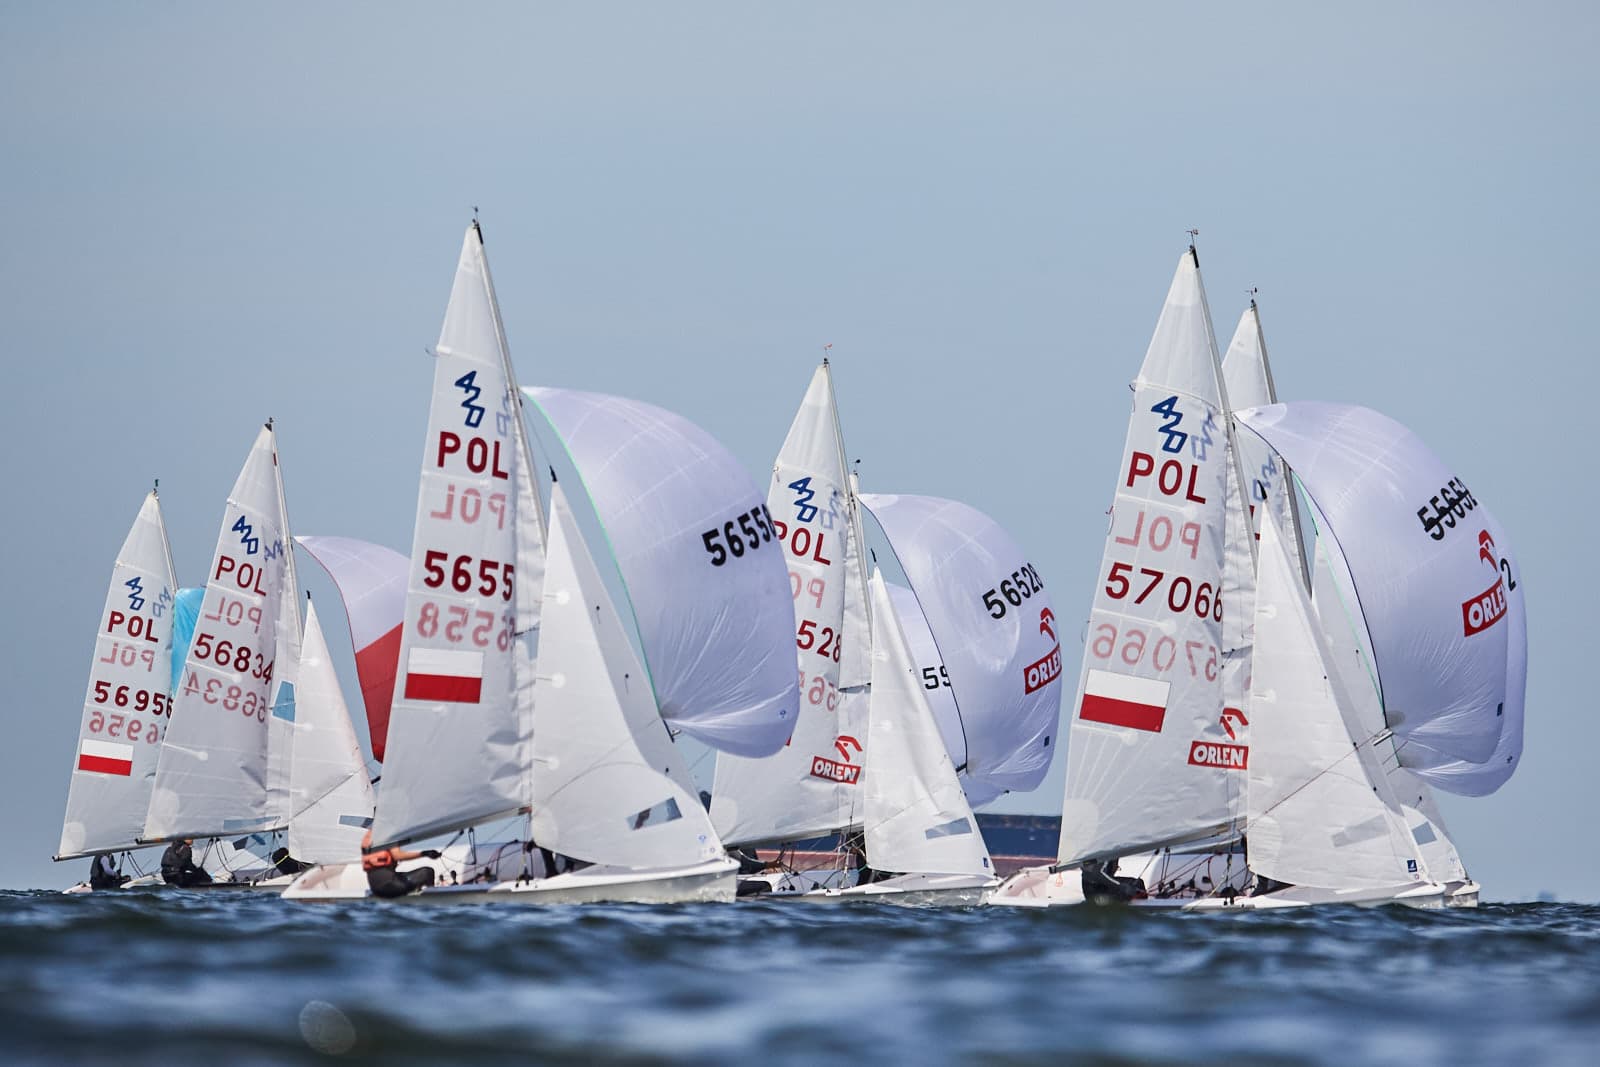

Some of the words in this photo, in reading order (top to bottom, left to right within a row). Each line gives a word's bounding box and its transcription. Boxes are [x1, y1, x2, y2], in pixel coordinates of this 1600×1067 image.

[437, 431, 509, 480] POL
[1126, 451, 1206, 504] POL
[214, 555, 267, 596] POL
[981, 562, 1044, 620] 56528
[1105, 562, 1223, 622] 57066
[108, 611, 159, 642] POL
[194, 633, 273, 685] 56834
[94, 681, 173, 718] 56956
[814, 756, 858, 782] ORLEN
[1193, 745, 1245, 767] ORLEN
